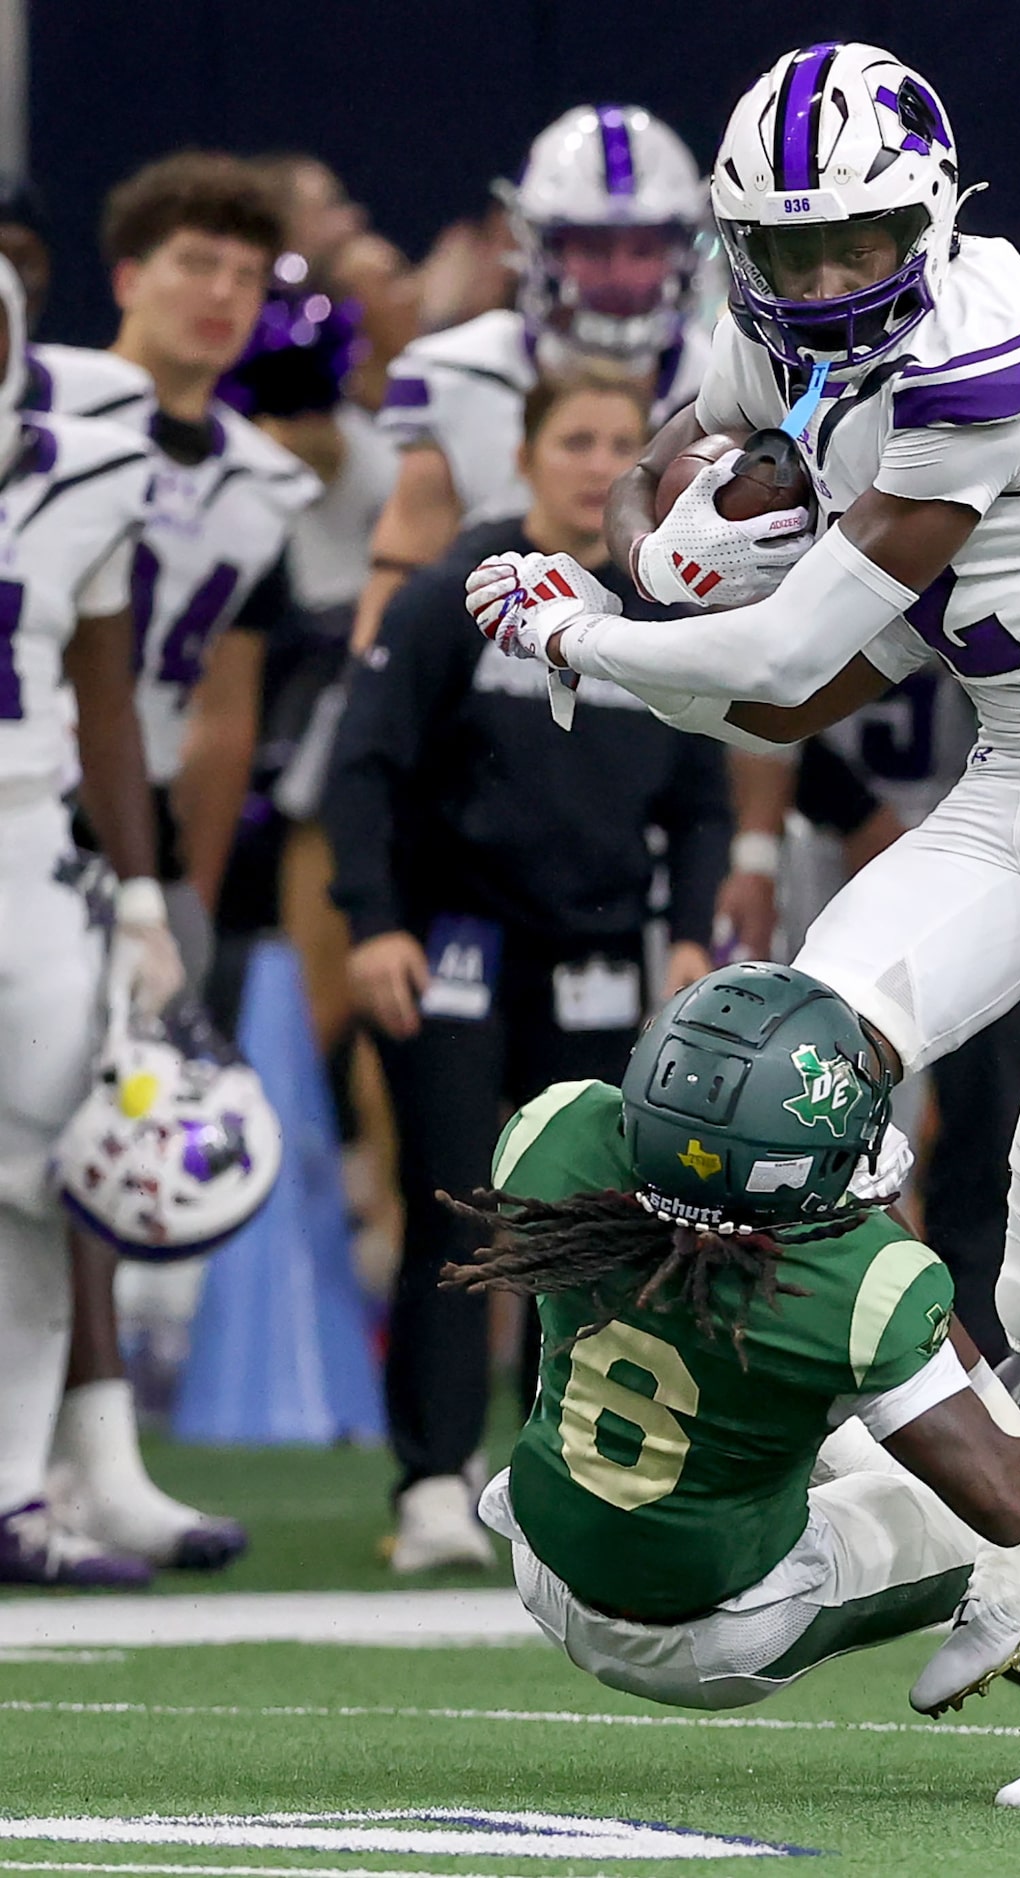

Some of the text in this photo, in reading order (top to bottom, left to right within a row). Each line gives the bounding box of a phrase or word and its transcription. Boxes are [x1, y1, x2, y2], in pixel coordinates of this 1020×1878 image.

[783, 197, 811, 213] 936
[811, 1069, 850, 1110] DE
[650, 1191, 723, 1224] schutt
[558, 1319, 700, 1511] 6
